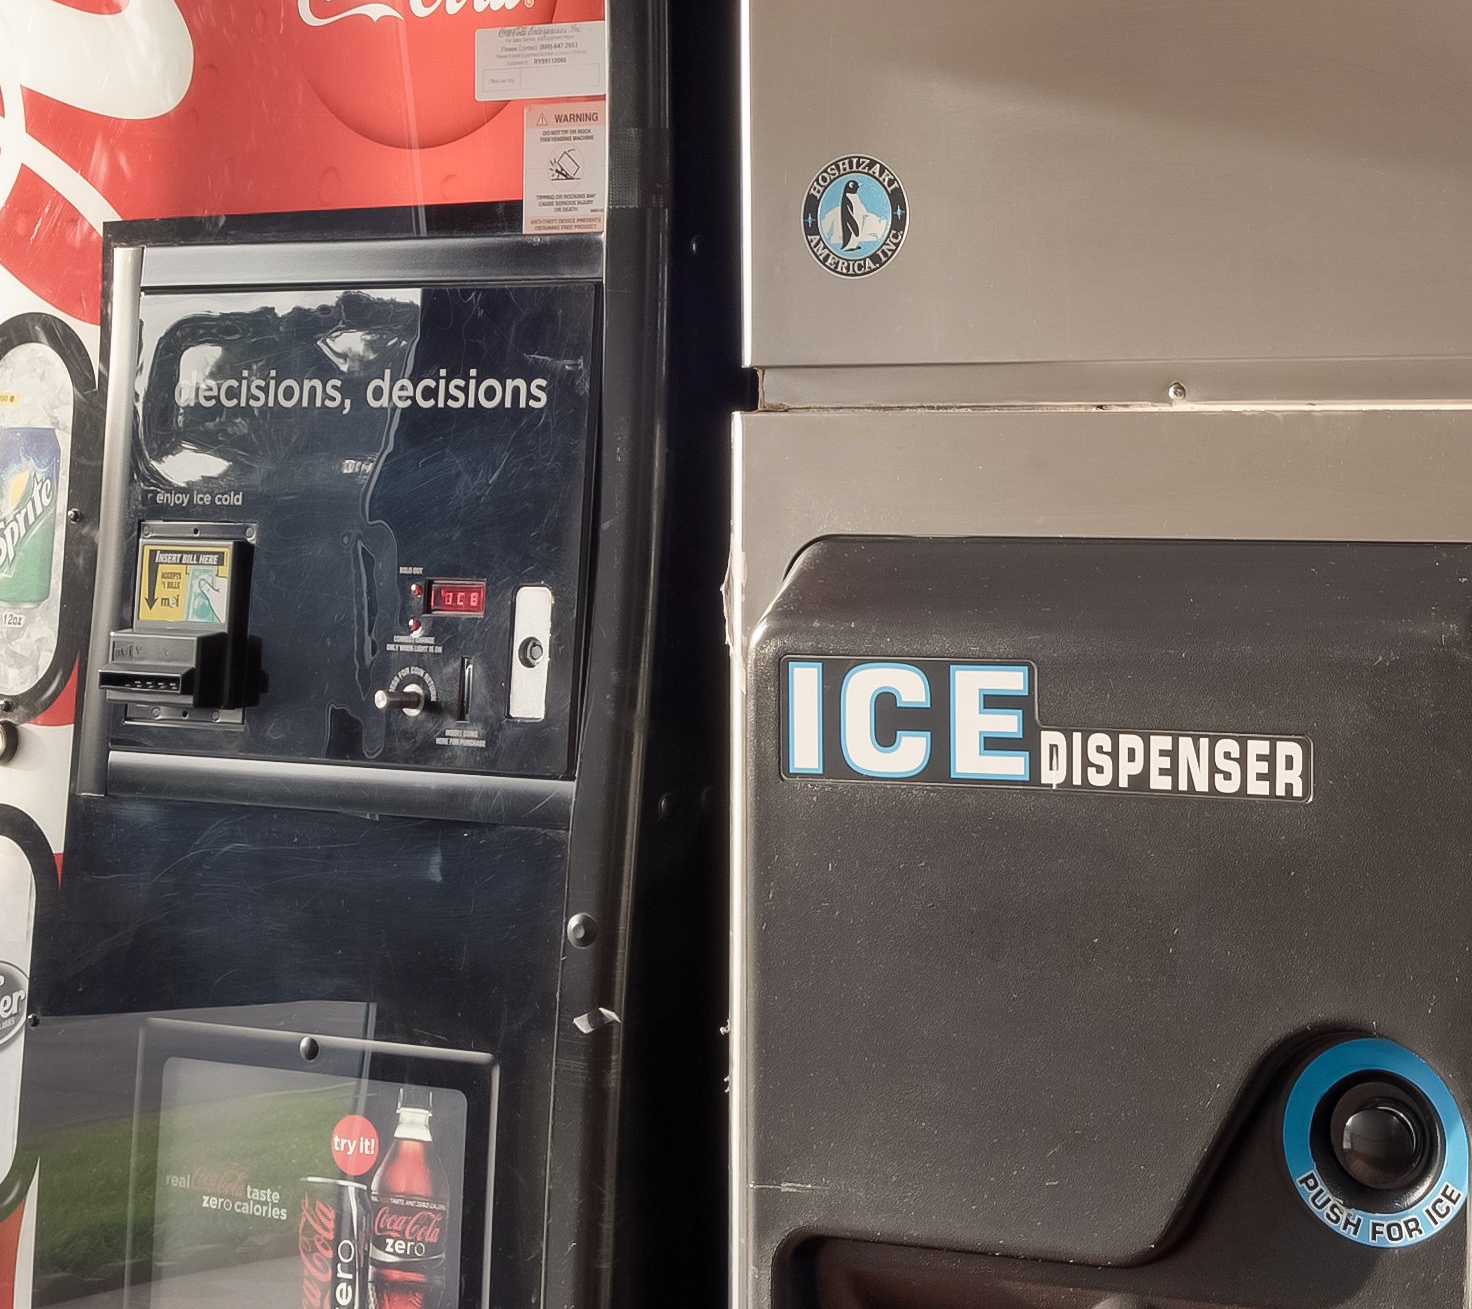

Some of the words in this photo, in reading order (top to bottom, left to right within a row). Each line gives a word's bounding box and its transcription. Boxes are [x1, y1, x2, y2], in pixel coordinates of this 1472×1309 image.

[554, 113, 599, 123] WARNING
[809, 157, 900, 201] HOSHIZAKI
[807, 234, 880, 275] AMERICA,
[877, 229, 904, 262] INC.
[174, 369, 351, 415] decisions,
[367, 369, 548, 410] decisions
[156, 492, 190, 507] enjoy
[193, 491, 211, 505] ice
[214, 491, 243, 506] cold
[155, 550, 181, 564] INSERT
[182, 554, 198, 564] BILL
[199, 554, 219, 565] HERE
[2, 614, 23, 626] 12oz
[787, 660, 1032, 781] ICE
[1038, 730, 1306, 799] DISPENSER
[333, 1135, 357, 1157] try
[359, 1136, 376, 1155] it!
[165, 1173, 191, 1190] real
[247, 1183, 280, 1204] taste
[202, 1193, 233, 1212] zero
[234, 1198, 288, 1221] calories
[1295, 1169, 1364, 1242] PUSH
[1369, 1216, 1424, 1245] FOR
[1424, 1181, 1465, 1232] ICE
[374, 1206, 442, 1244] Coca-Cola
[385, 1238, 426, 1257] zero
